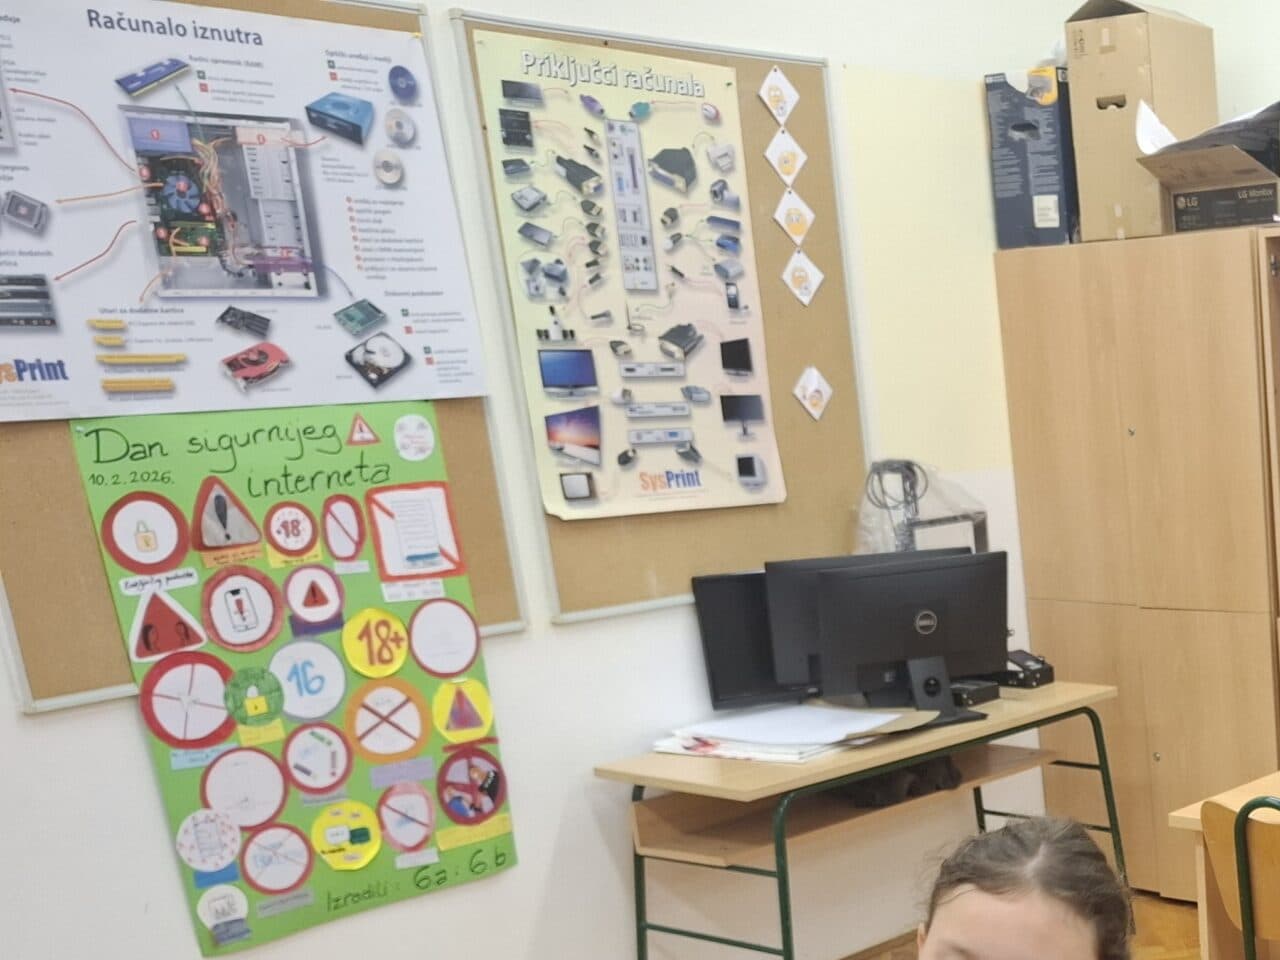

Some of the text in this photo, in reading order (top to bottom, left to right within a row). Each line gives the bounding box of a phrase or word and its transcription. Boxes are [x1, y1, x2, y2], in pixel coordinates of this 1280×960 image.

[87, 8, 263, 46] Računalo iznutra
[521, 50, 705, 98] Priključci računala
[0, 359, 70, 385] sPrint
[85, 426, 168, 464] Dan
[186, 421, 342, 474] sigurnijeg
[247, 450, 391, 498] interneta
[639, 469, 702, 491] SysPrint
[357, 617, 405, 667] 18+
[287, 660, 325, 696] 16
